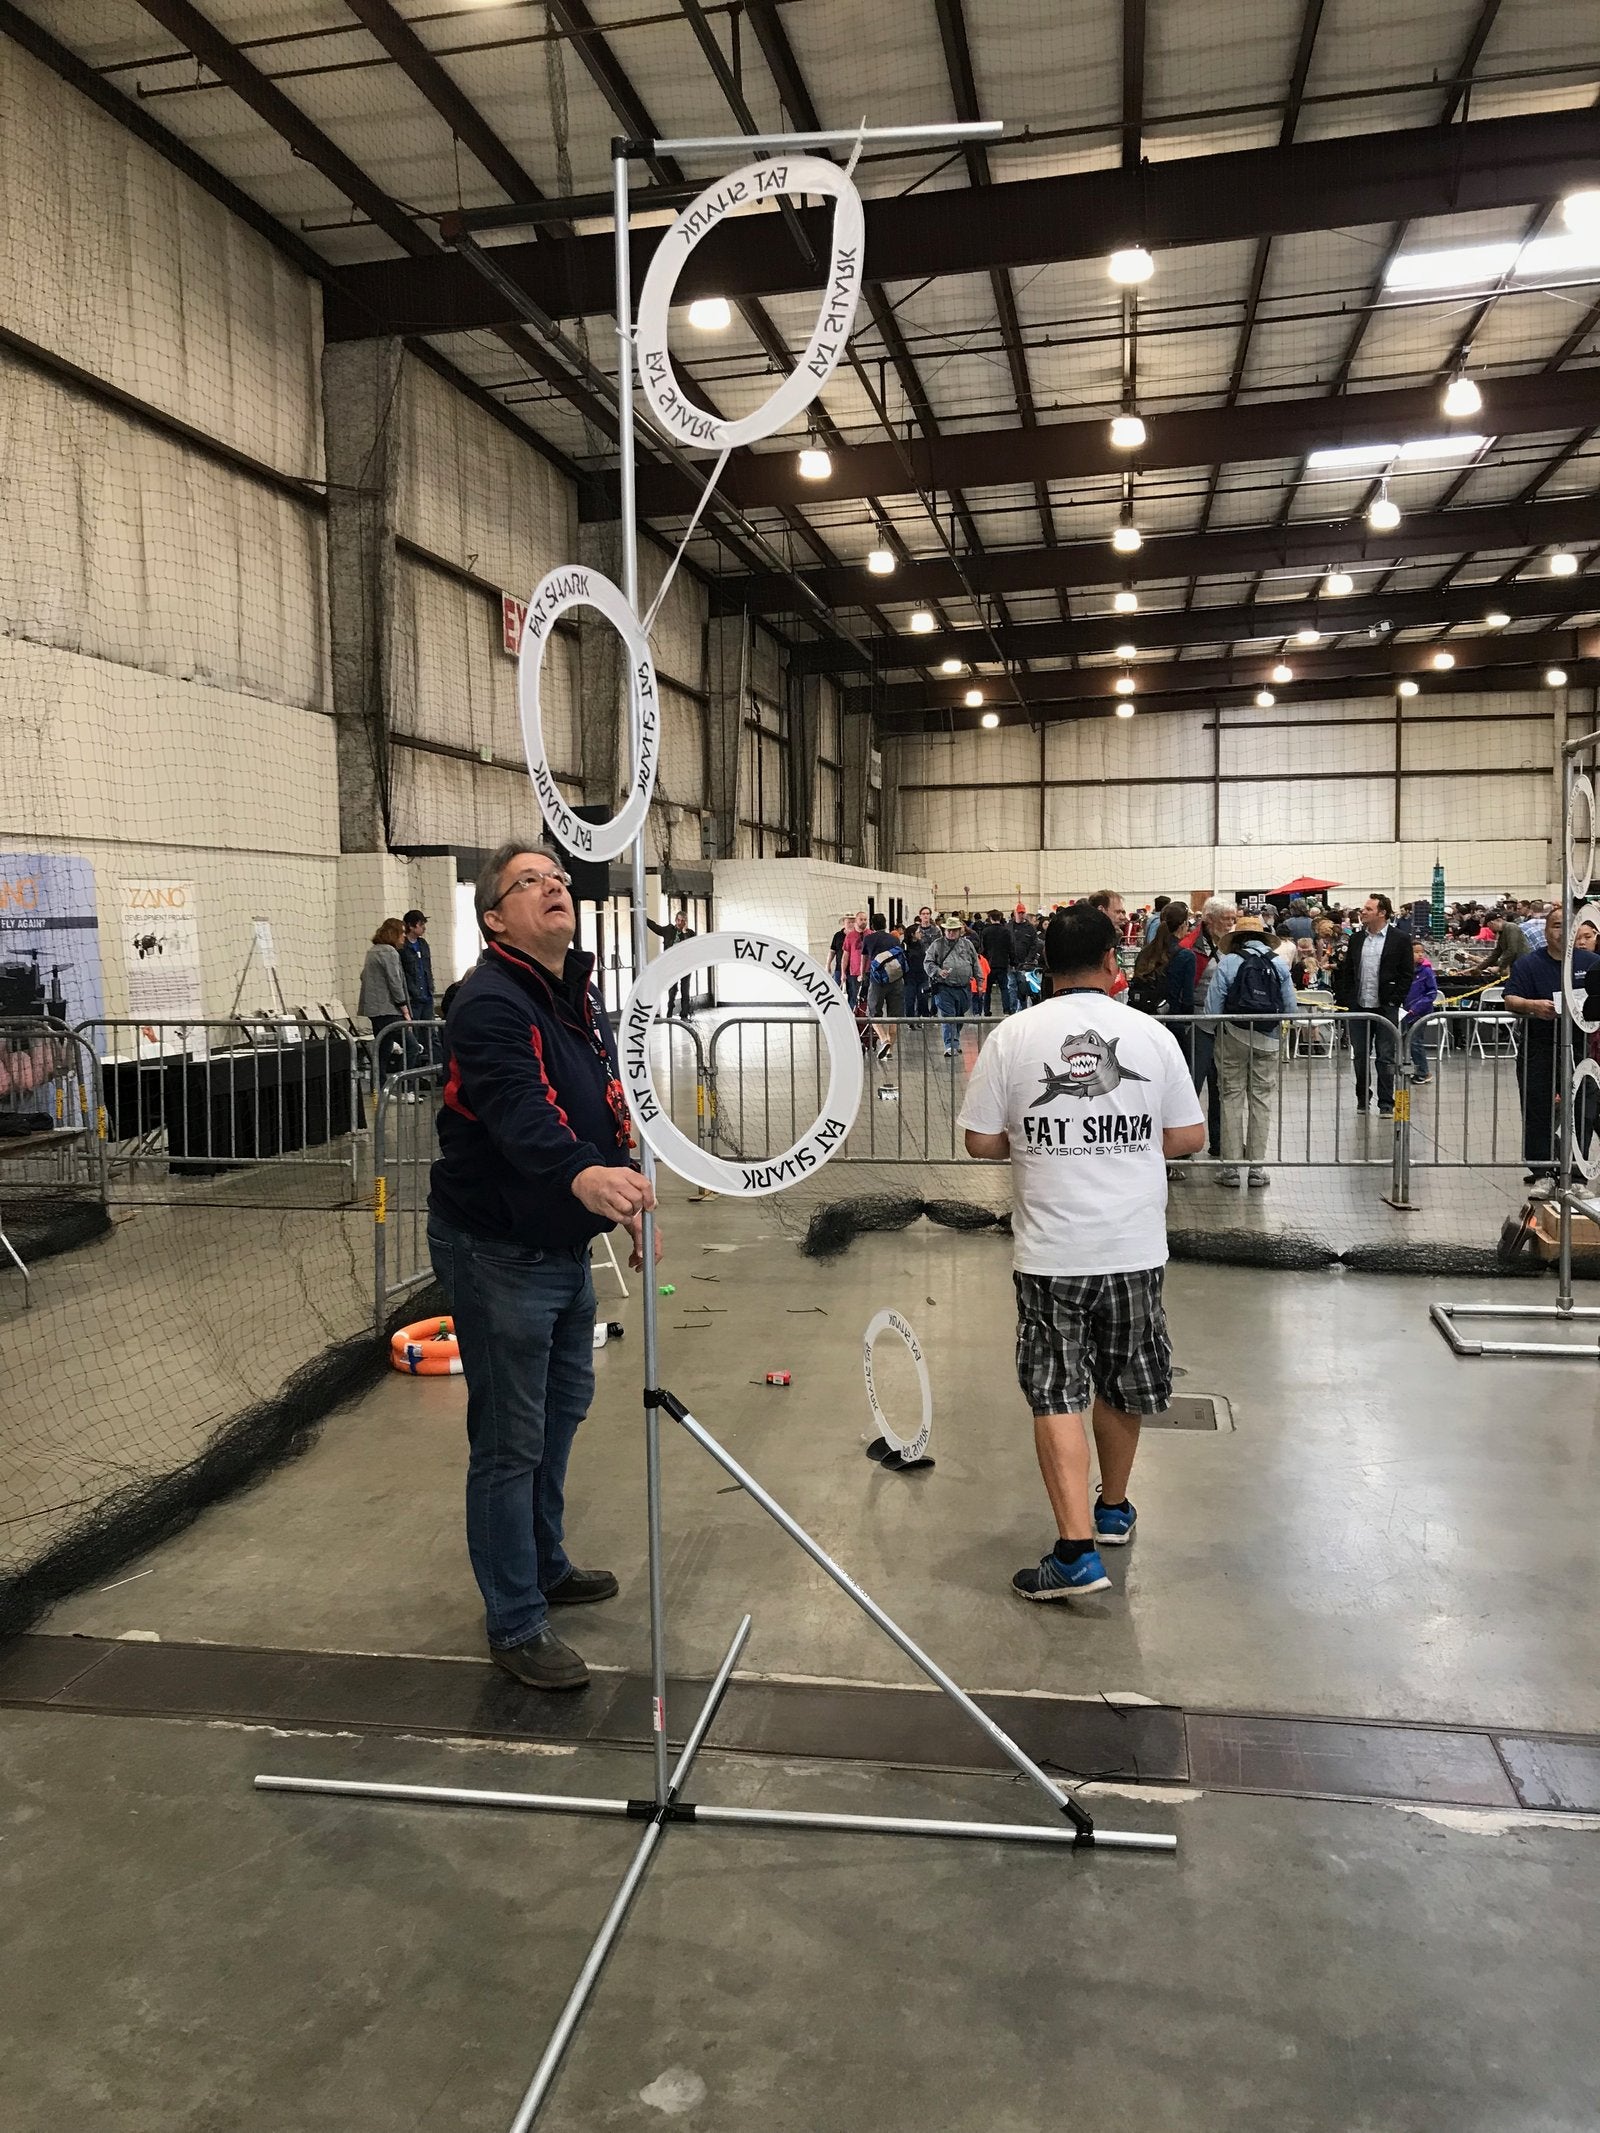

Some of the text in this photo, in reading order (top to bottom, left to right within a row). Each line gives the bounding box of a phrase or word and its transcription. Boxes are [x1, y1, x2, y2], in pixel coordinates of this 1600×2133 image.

[504, 597, 529, 653] EX
[529, 573, 591, 639] FAT SHARK
[637, 661, 656, 797] FAT SHARK
[532, 760, 593, 851] FAT SHARK
[1, 918, 46, 929] FLY AGAIN?
[733, 938, 841, 1015] FAT SHARK
[626, 998, 659, 1123] FAT SHARK
[741, 1118, 848, 1190] FAT SHARK
[1023, 1113, 1153, 1147] FAT SHARK
[1026, 1146, 1042, 1156] RC
[1045, 1147, 1092, 1156] VISION
